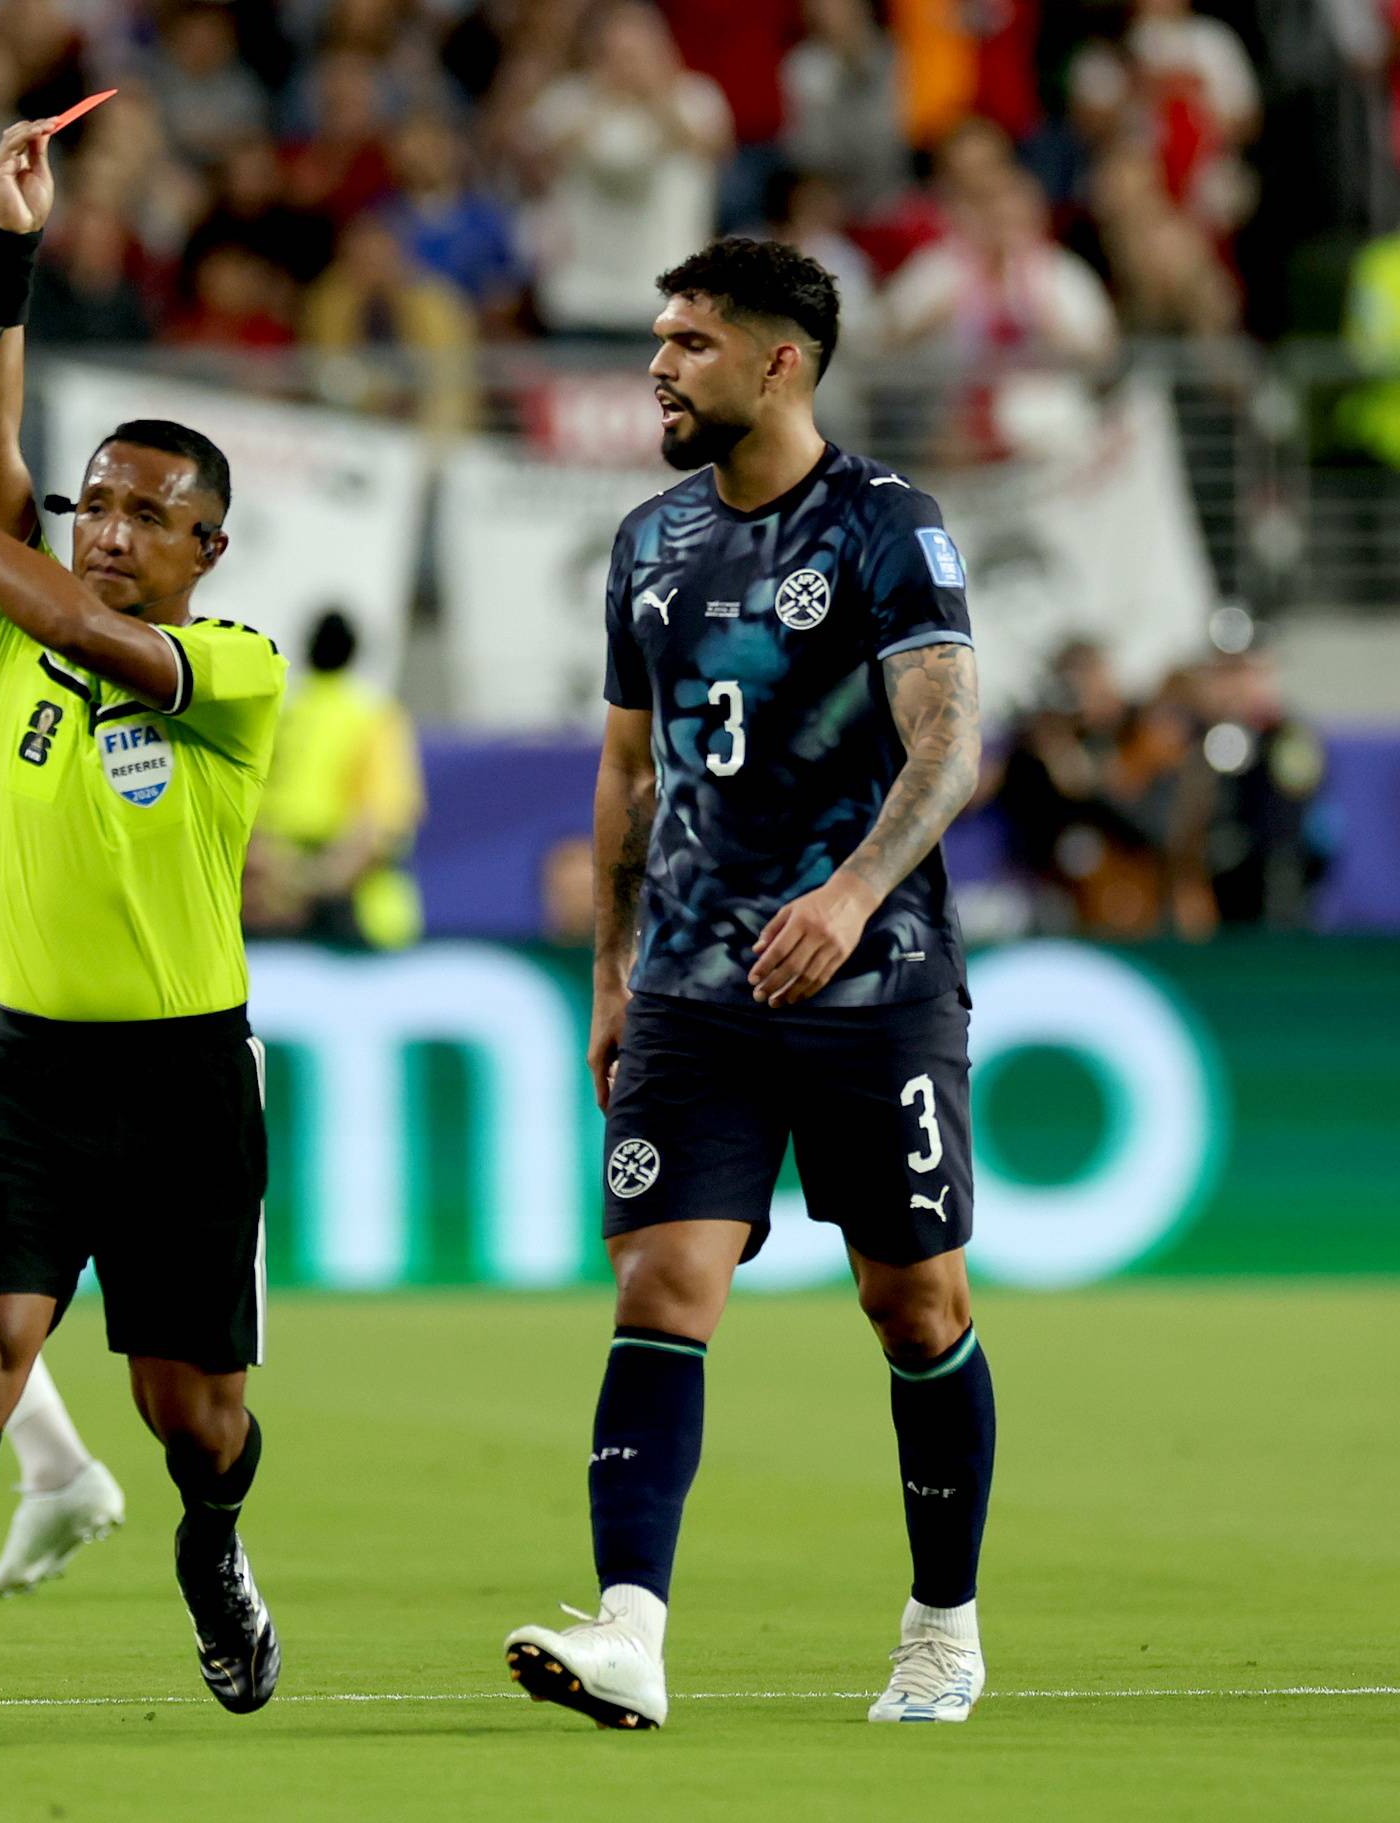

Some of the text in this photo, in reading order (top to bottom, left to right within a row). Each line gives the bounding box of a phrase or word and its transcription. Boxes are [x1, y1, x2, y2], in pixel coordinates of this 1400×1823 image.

[104, 725, 162, 754] FIFA
[706, 681, 746, 777] 3
[111, 756, 167, 779] REFEREE
[133, 785, 158, 800] 2026
[900, 1074, 943, 1174] 3
[588, 1447, 638, 1466] APF
[906, 1480, 957, 1499] APF
